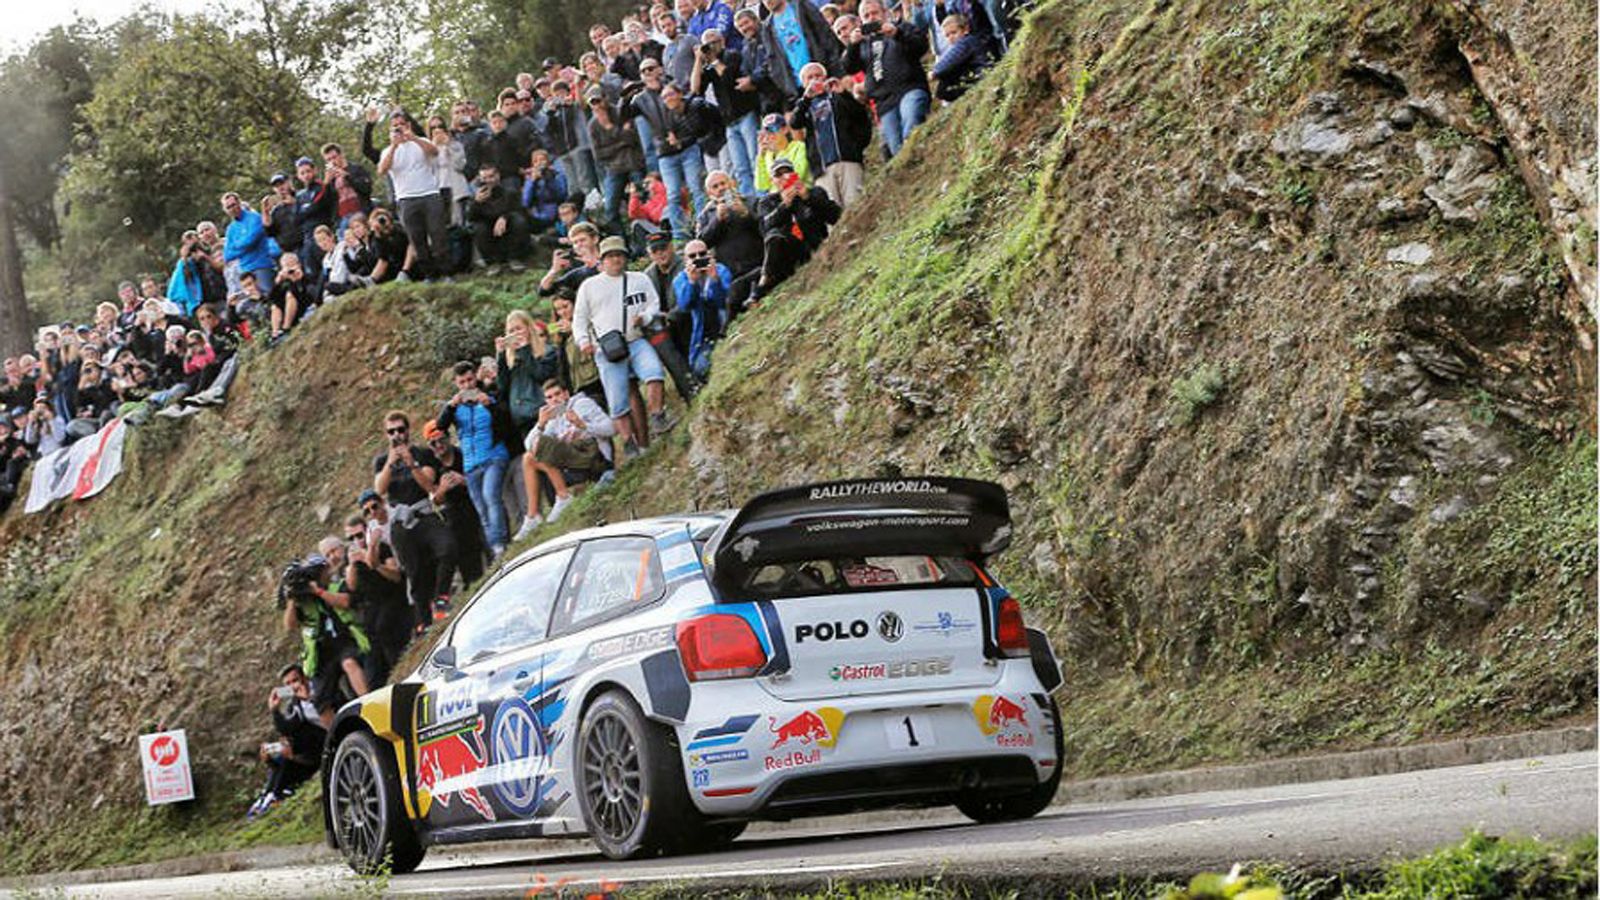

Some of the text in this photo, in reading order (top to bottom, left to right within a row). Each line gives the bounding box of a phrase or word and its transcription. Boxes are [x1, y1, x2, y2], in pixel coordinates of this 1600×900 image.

[795, 619, 869, 643] POLO
[842, 655, 955, 680] Castrol EDGE
[902, 716, 919, 747] 1
[764, 754, 794, 770] Red
[794, 750, 821, 766] Bull
